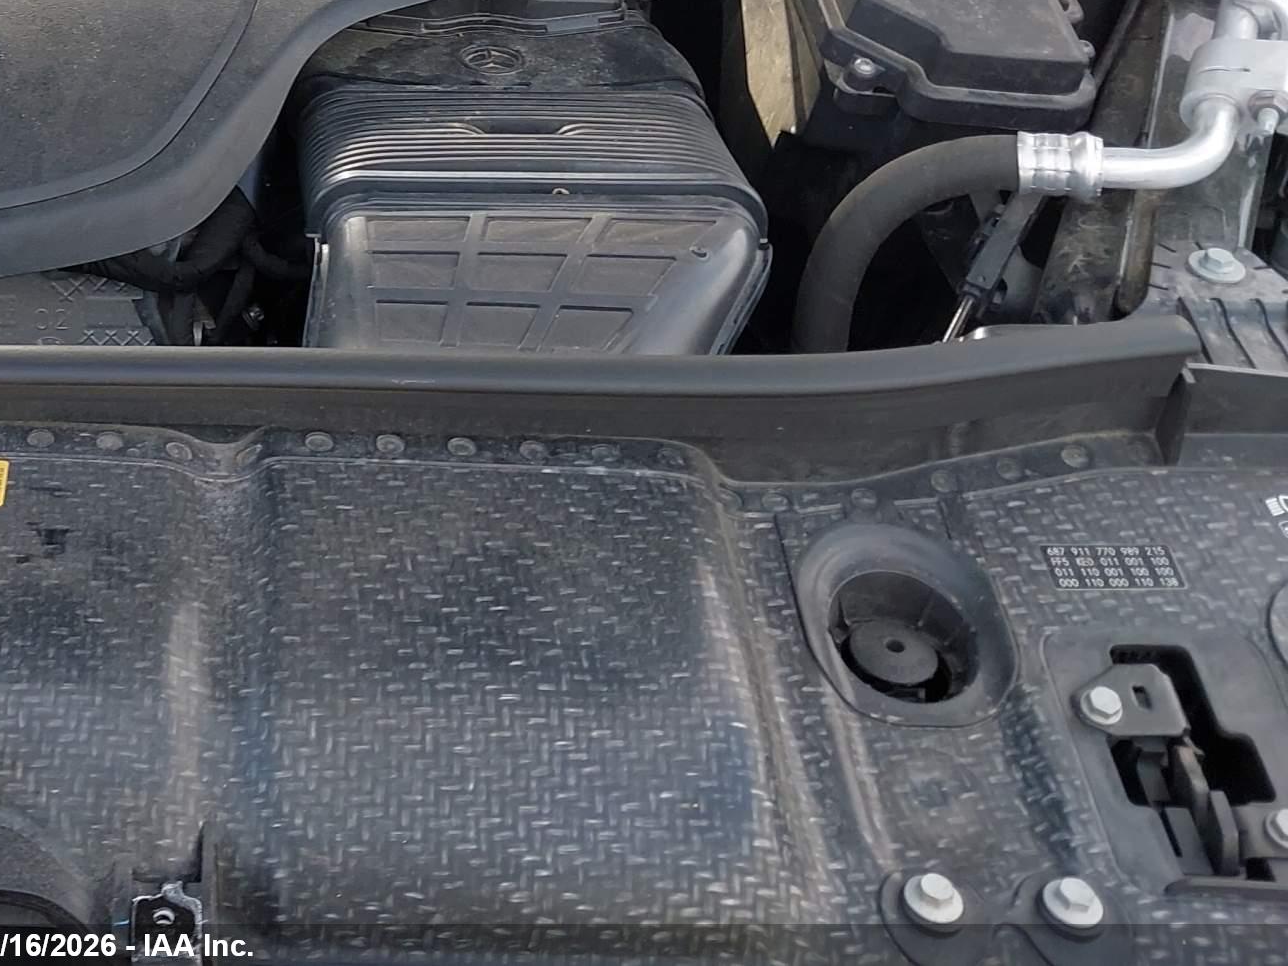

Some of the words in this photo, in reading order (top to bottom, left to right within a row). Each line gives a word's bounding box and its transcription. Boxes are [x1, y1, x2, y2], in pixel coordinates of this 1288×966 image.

[1070, 546, 1091, 556] 911
[1096, 546, 1116, 556] 770
[1145, 546, 1165, 556] 215
[1100, 557, 1119, 566] 011
[1150, 557, 1169, 566] 100
[1054, 567, 1074, 576] 011
[1081, 567, 1100, 576] 110
[1104, 567, 1124, 576] 001
[1130, 567, 1149, 576] 100
[1058, 578, 1079, 587] 000
[1085, 578, 1104, 587] 110
[1109, 578, 1129, 587] 000
[1134, 578, 1154, 587] 110
